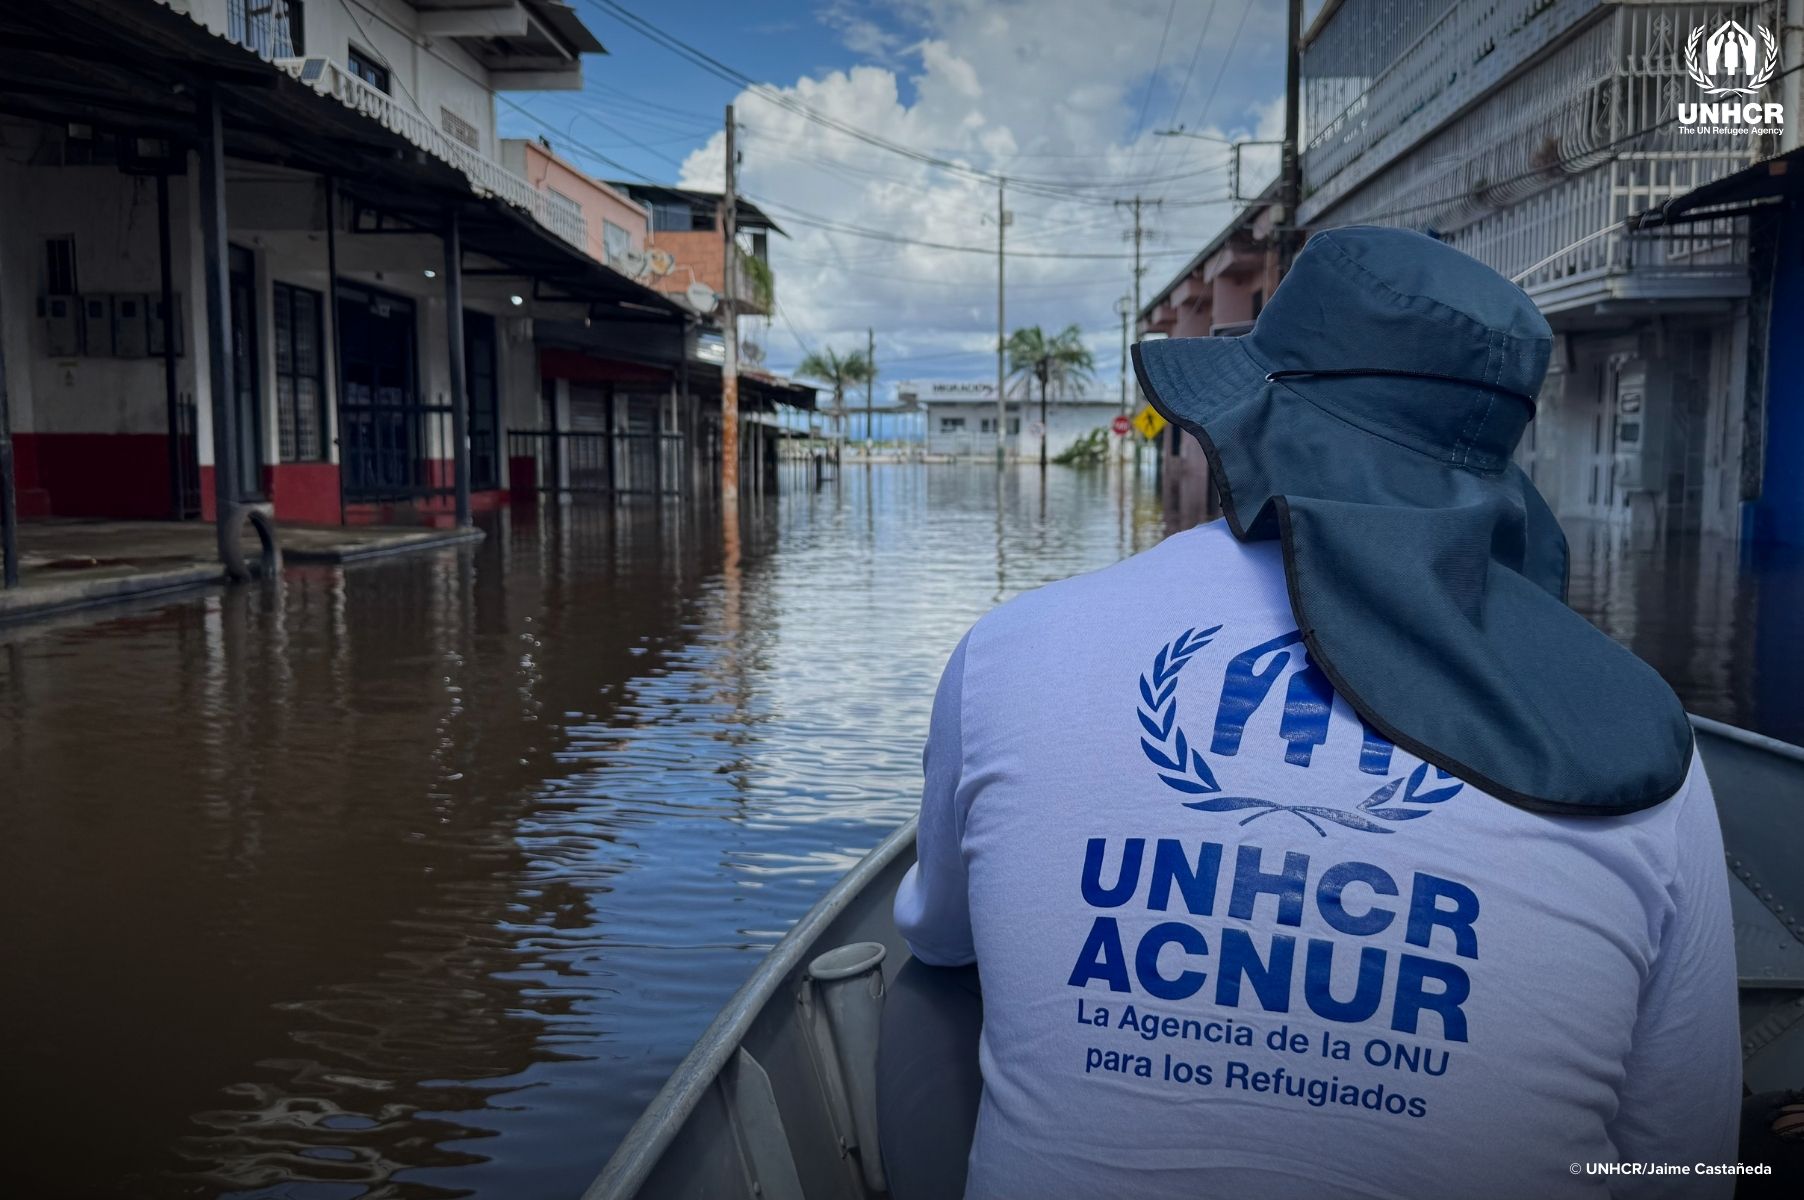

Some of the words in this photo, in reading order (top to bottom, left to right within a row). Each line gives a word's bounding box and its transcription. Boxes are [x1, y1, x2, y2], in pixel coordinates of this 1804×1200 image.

[1080, 837, 1480, 961] UNHCR
[1067, 916, 1471, 1044] ACNUR
[1077, 998, 1110, 1028] La
[1117, 1004, 1254, 1047] Agencia
[1266, 1024, 1310, 1054] de
[1321, 1030, 1351, 1061] la
[1363, 1038, 1450, 1077] ONU
[1085, 1047, 1153, 1079] para
[1163, 1053, 1213, 1086] los
[1224, 1060, 1427, 1119] Refugiados
